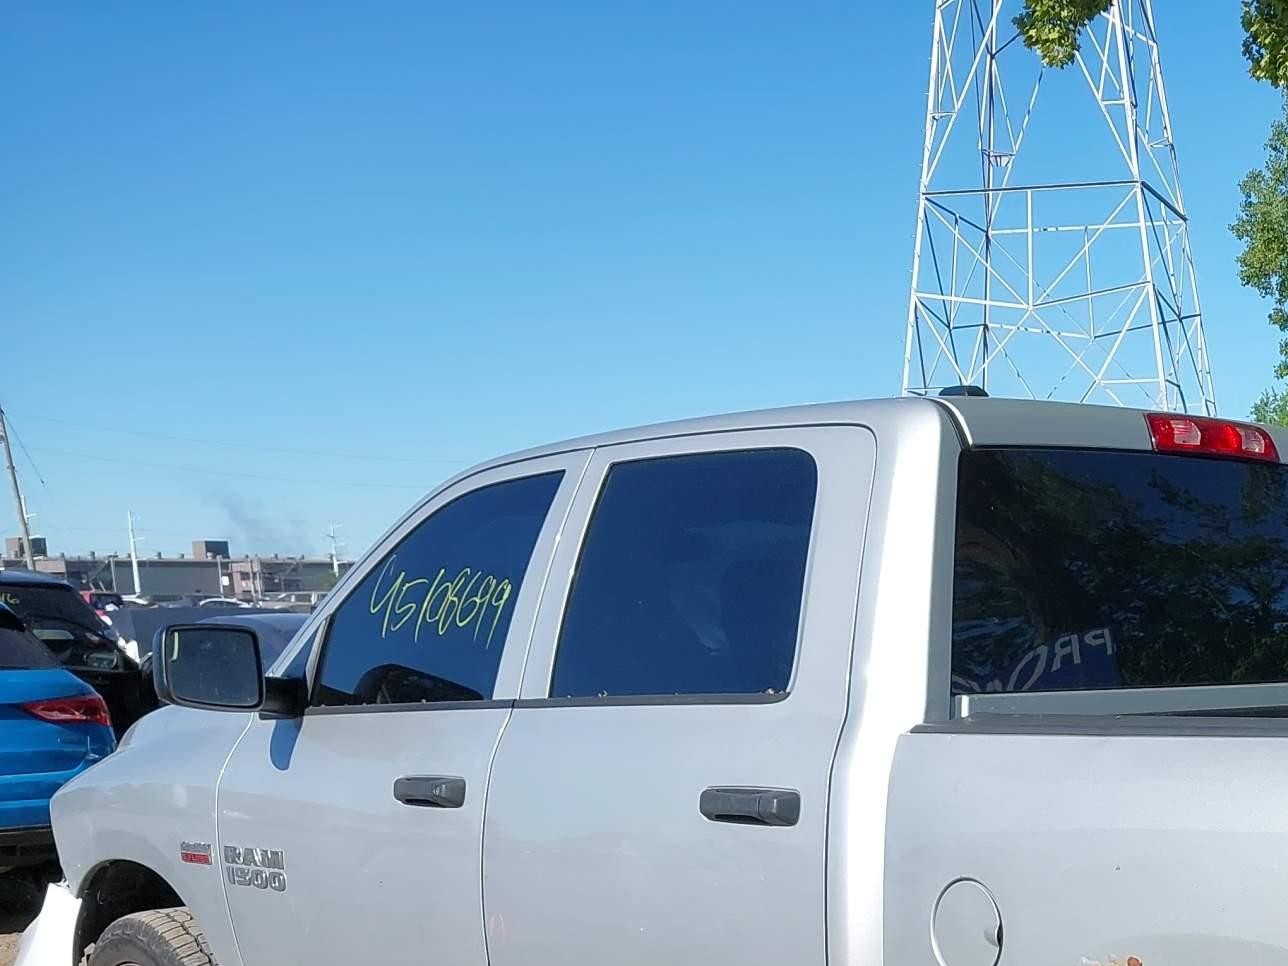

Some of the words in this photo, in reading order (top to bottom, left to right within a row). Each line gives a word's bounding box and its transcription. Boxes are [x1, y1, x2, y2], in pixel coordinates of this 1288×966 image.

[370, 554, 512, 649] 45108699
[223, 845, 285, 870] RAM
[226, 866, 287, 892] 1500
